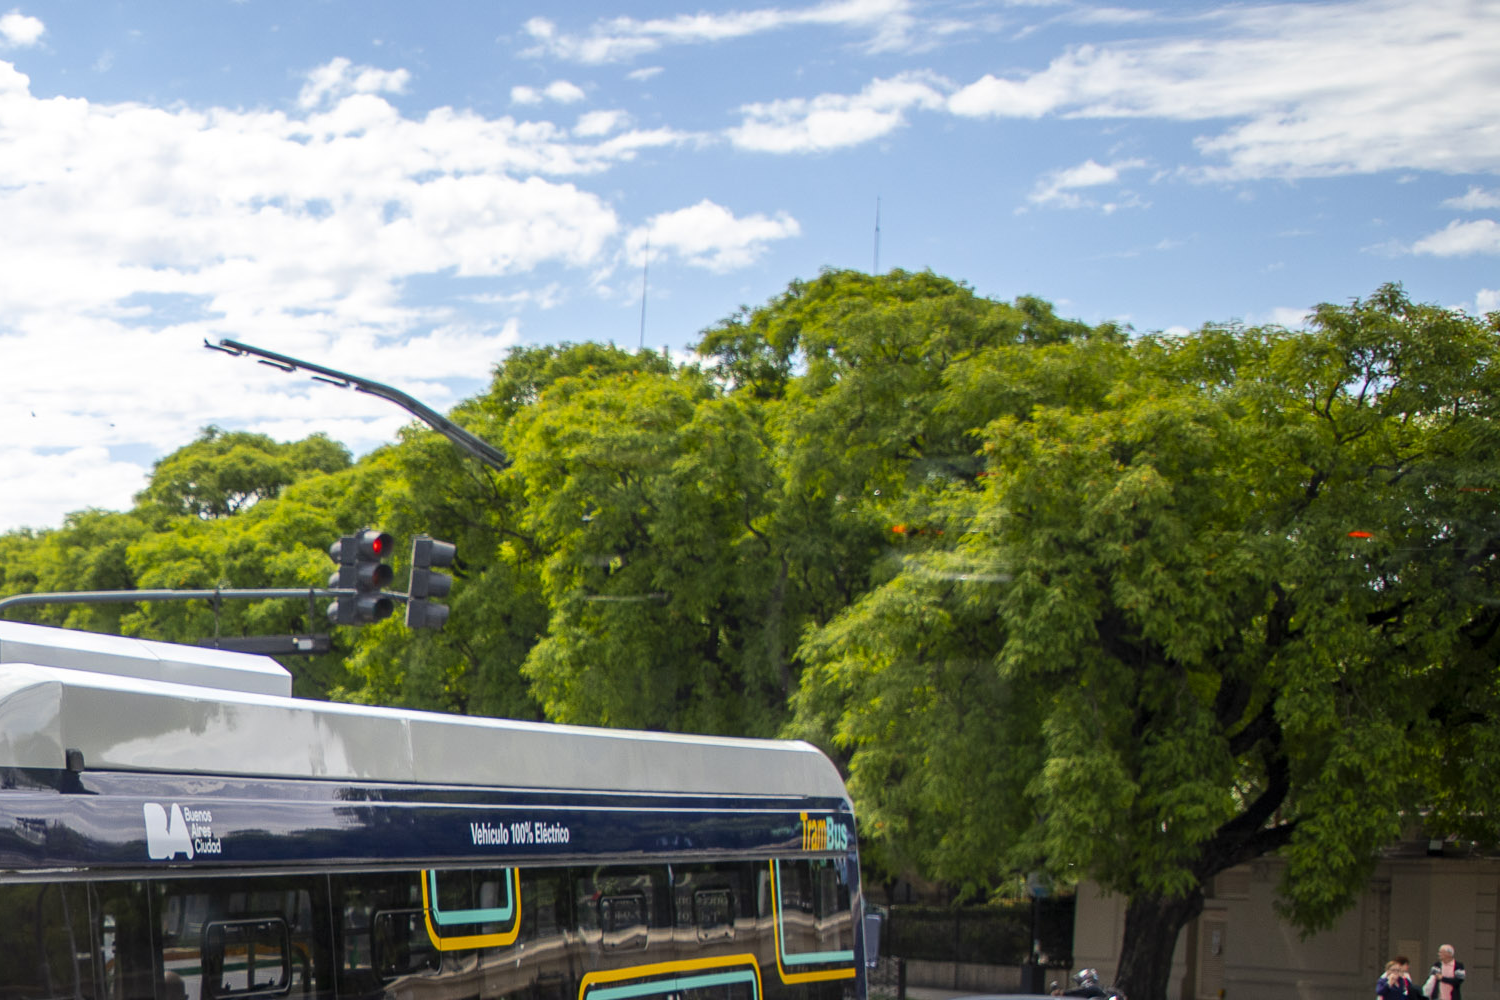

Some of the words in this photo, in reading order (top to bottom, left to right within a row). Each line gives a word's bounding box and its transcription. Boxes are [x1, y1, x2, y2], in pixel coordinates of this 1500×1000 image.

[184, 807, 212, 822] Buenos
[192, 823, 211, 838] Aires
[470, 822, 509, 845] Vehículo
[511, 821, 533, 844] 100%
[534, 821, 570, 844] Eléctrico
[800, 811, 848, 851] TramBus
[195, 838, 221, 854] Ciudad
